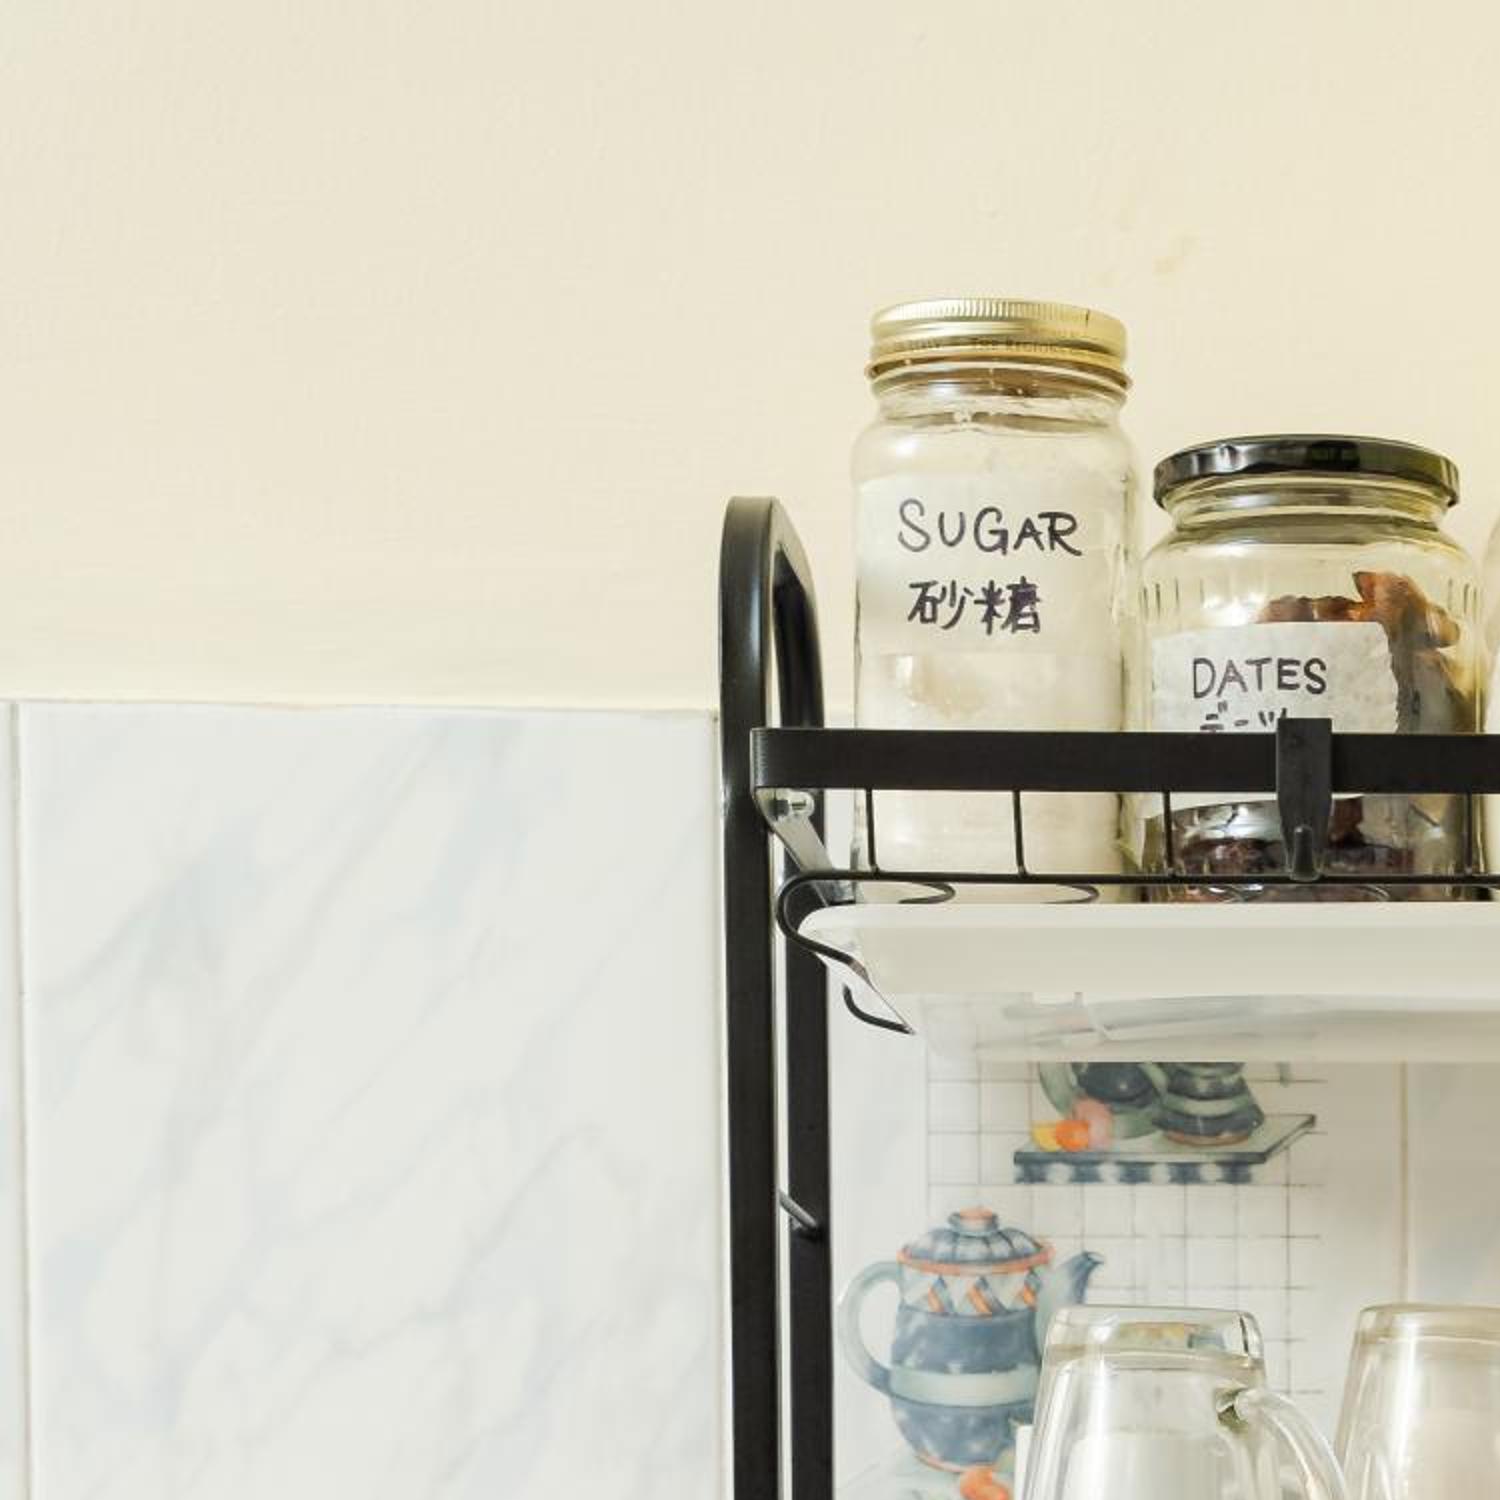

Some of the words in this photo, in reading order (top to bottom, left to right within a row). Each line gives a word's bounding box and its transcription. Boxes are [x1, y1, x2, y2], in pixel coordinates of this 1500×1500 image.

[897, 498, 1083, 556] SUGAR
[907, 575, 1042, 636] 砂糖
[1192, 657, 1327, 699] DATES
